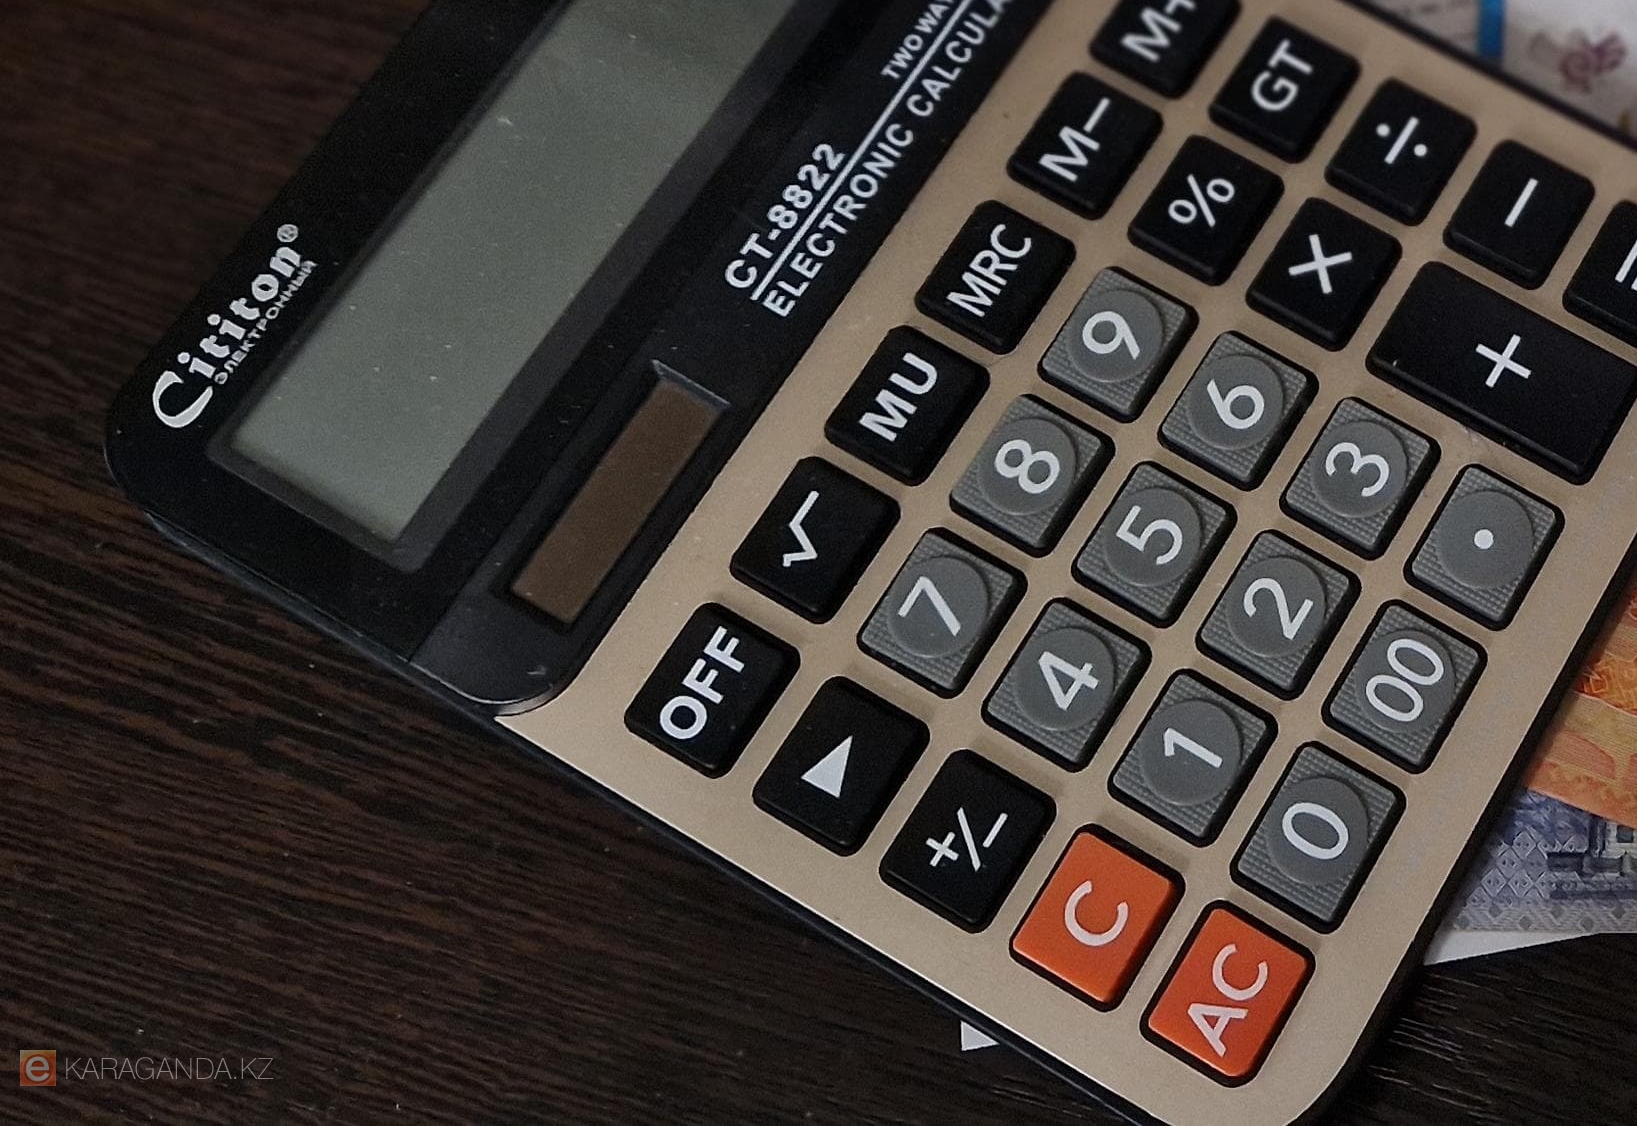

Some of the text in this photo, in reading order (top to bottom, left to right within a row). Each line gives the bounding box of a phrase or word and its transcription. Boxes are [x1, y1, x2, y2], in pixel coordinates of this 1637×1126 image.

[880, 34, 923, 80] TWO
[1250, 38, 1315, 113] GT
[724, 143, 845, 289] CT-8822
[762, 122, 914, 318] ELECTRONIC
[1167, 173, 1236, 228] %
[946, 223, 1032, 318] MRC
[213, 259, 319, 386] ЭЛЕКТРОННЫЙ
[1081, 309, 1142, 361] 9
[858, 351, 939, 443] MU
[1205, 378, 1266, 430] 6
[993, 438, 1062, 495] 8
[1324, 441, 1391, 498] 3
[1114, 504, 1184, 566] 5
[896, 575, 962, 638] 7
[1242, 576, 1315, 642] 2
[658, 624, 746, 741] OFF
[1037, 650, 1100, 712] 4
[1364, 637, 1445, 723] 00
[1162, 726, 1224, 769] 1
[924, 806, 1009, 873] +/-
[1280, 801, 1350, 861] 0
[1063, 879, 1130, 948] C
[1186, 942, 1270, 1059] AC
